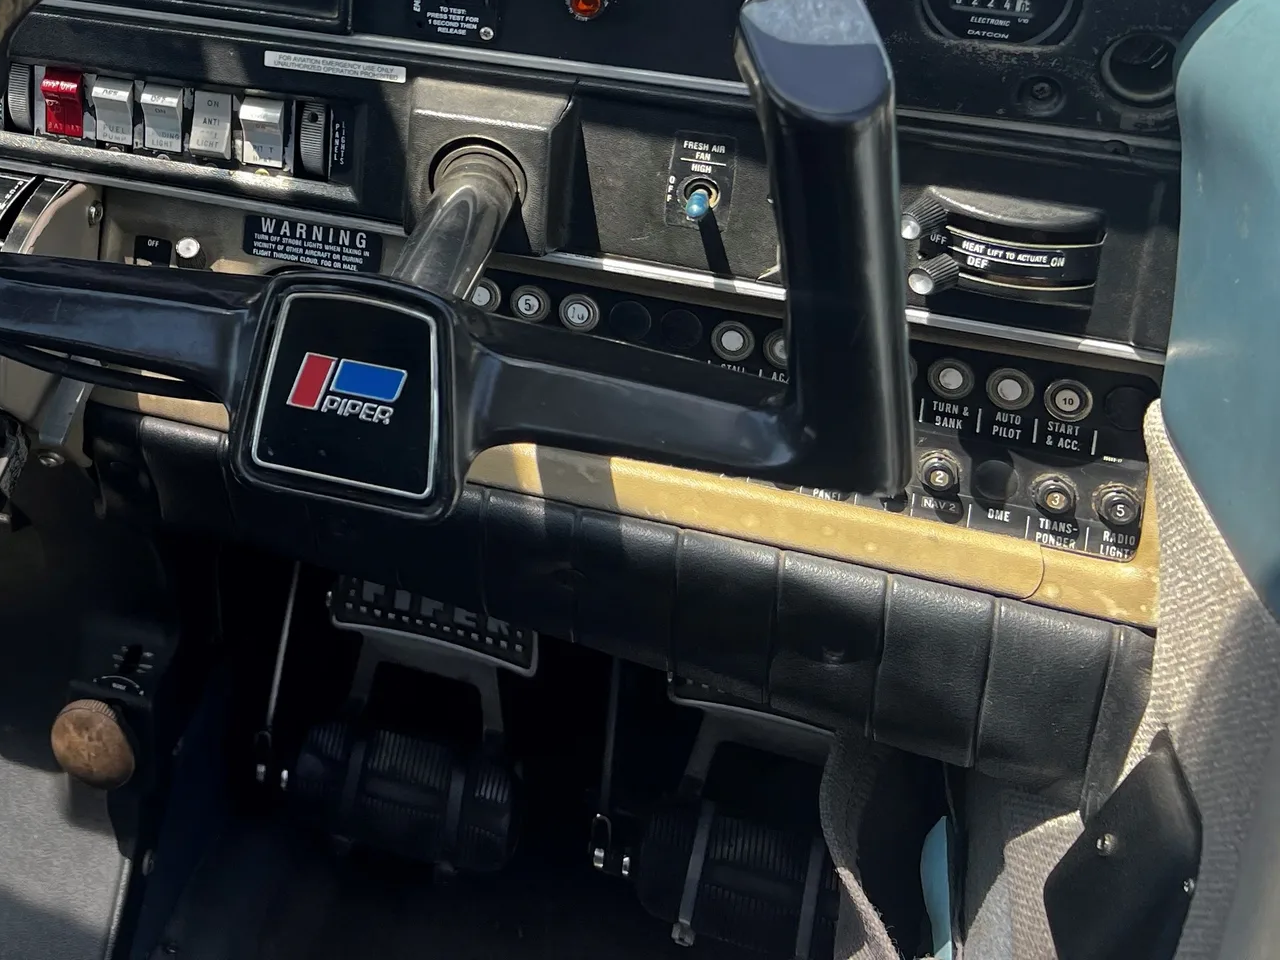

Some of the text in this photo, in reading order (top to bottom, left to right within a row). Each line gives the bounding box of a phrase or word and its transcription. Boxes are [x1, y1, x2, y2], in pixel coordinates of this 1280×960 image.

[970, 16, 1010, 26] ELECTRONIC
[967, 29, 1009, 39] DATCON
[684, 140, 726, 153] FRESH AIR
[695, 152, 711, 161] FAN
[691, 164, 712, 173] HIGH
[261, 217, 367, 249] WARNING
[147, 239, 159, 247] OFF
[253, 248, 271, 258] FLIGHT
[273, 251, 299, 261] THROUGH
[300, 256, 319, 265] CLOUD,
[320, 259, 332, 267] FOG
[962, 240, 1047, 264] HEAT LIFT TO ACTUATE
[967, 255, 988, 269] DEF
[1050, 257, 1065, 267] ON
[933, 400, 969, 417] TURN &
[1062, 397, 1074, 406] 10
[321, 395, 394, 425] PIPER
[995, 411, 1022, 425] AUTO
[992, 426, 1022, 440] PILOT
[1047, 421, 1080, 436] START
[1046, 435, 1080, 452] & ACC.
[935, 471, 943, 483] 2
[1052, 495, 1061, 506] 3
[987, 508, 1011, 523] DME
[1116, 505, 1125, 517] 5
[1039, 518, 1078, 533] TRANS-
[1035, 532, 1076, 549] PONDER
[1103, 531, 1136, 546] RADIO
